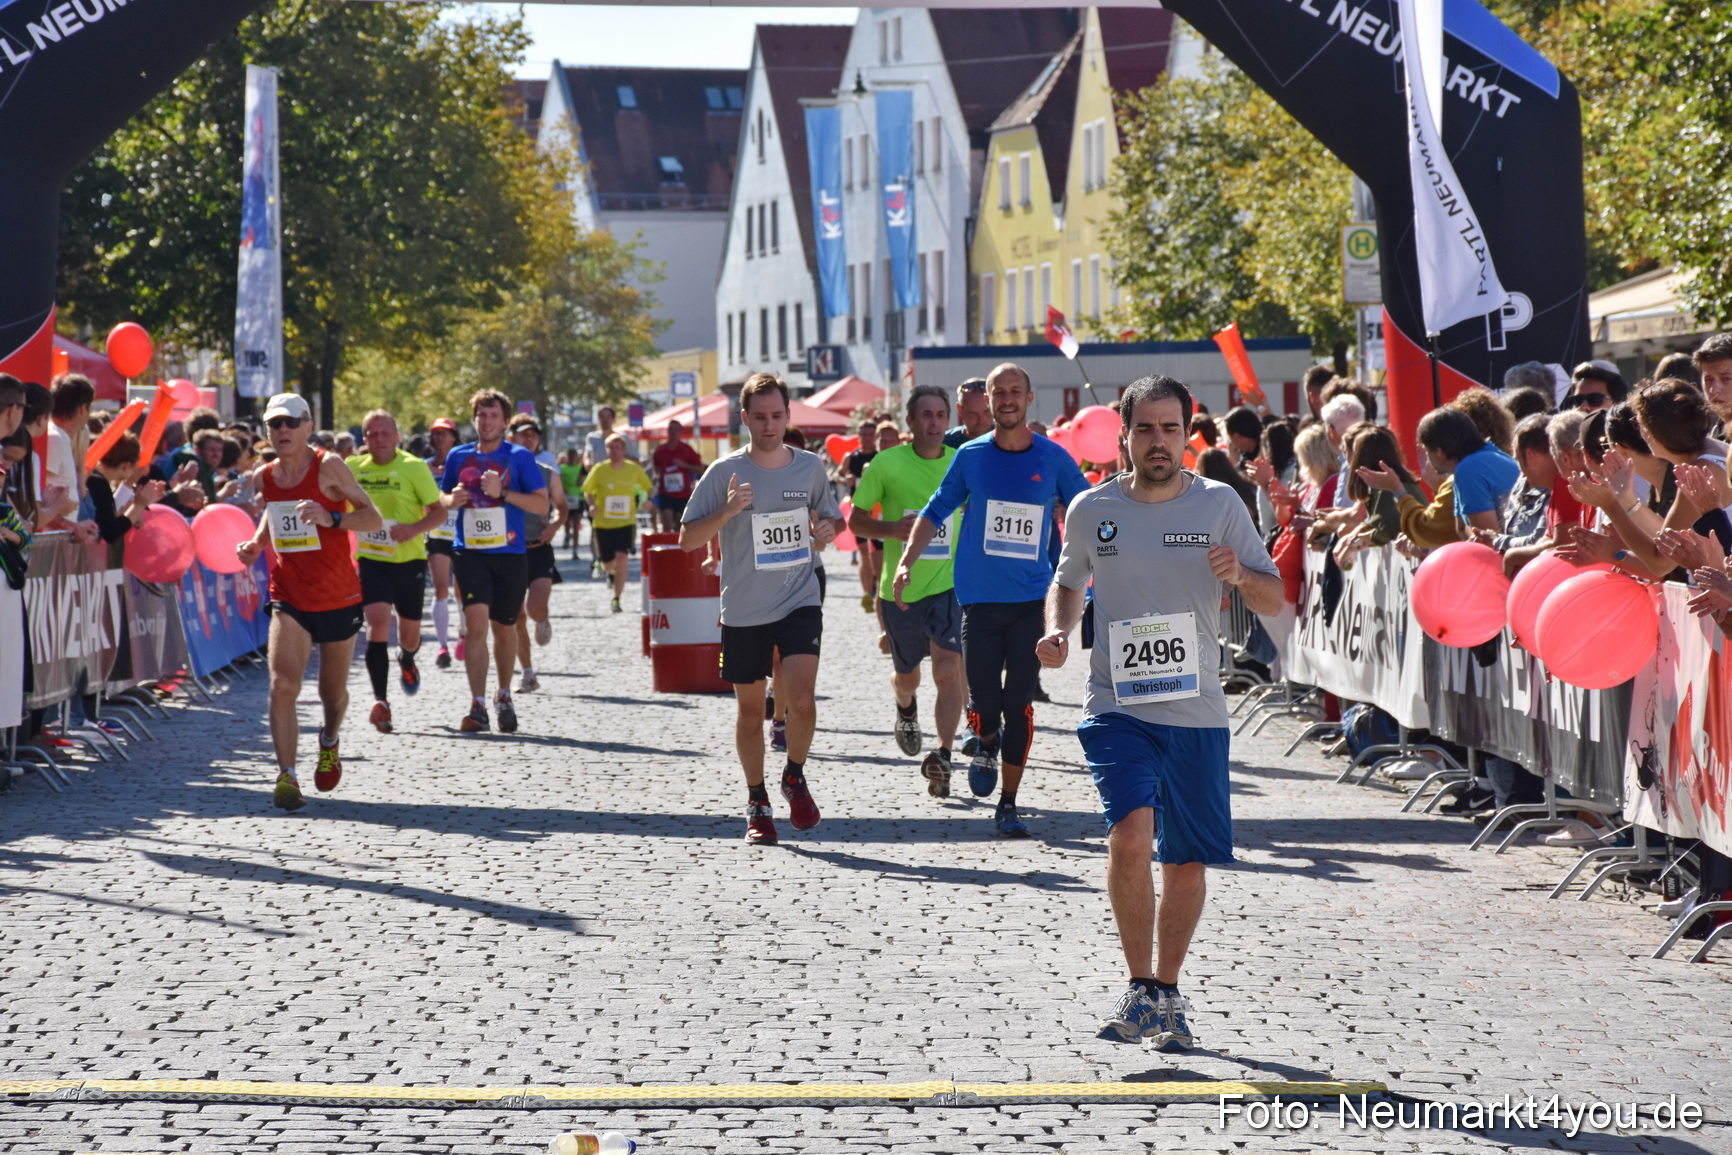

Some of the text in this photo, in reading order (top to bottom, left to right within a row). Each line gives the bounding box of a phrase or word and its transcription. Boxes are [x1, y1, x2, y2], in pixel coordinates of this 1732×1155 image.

[1326, 0, 1521, 119] NEURKT
[1408, 82, 1463, 217] NEUMAR
[1355, 237, 1370, 252] H
[282, 515, 298, 532] 31
[475, 520, 492, 532] 98
[994, 516, 1033, 536] 3116
[762, 525, 801, 545] 3015
[1164, 533, 1210, 544] BOCK
[1132, 622, 1170, 635] BOCK
[1122, 637, 1186, 669] 2496
[1149, 668, 1176, 676] Neumarkt
[1132, 679, 1182, 694] Christoph
